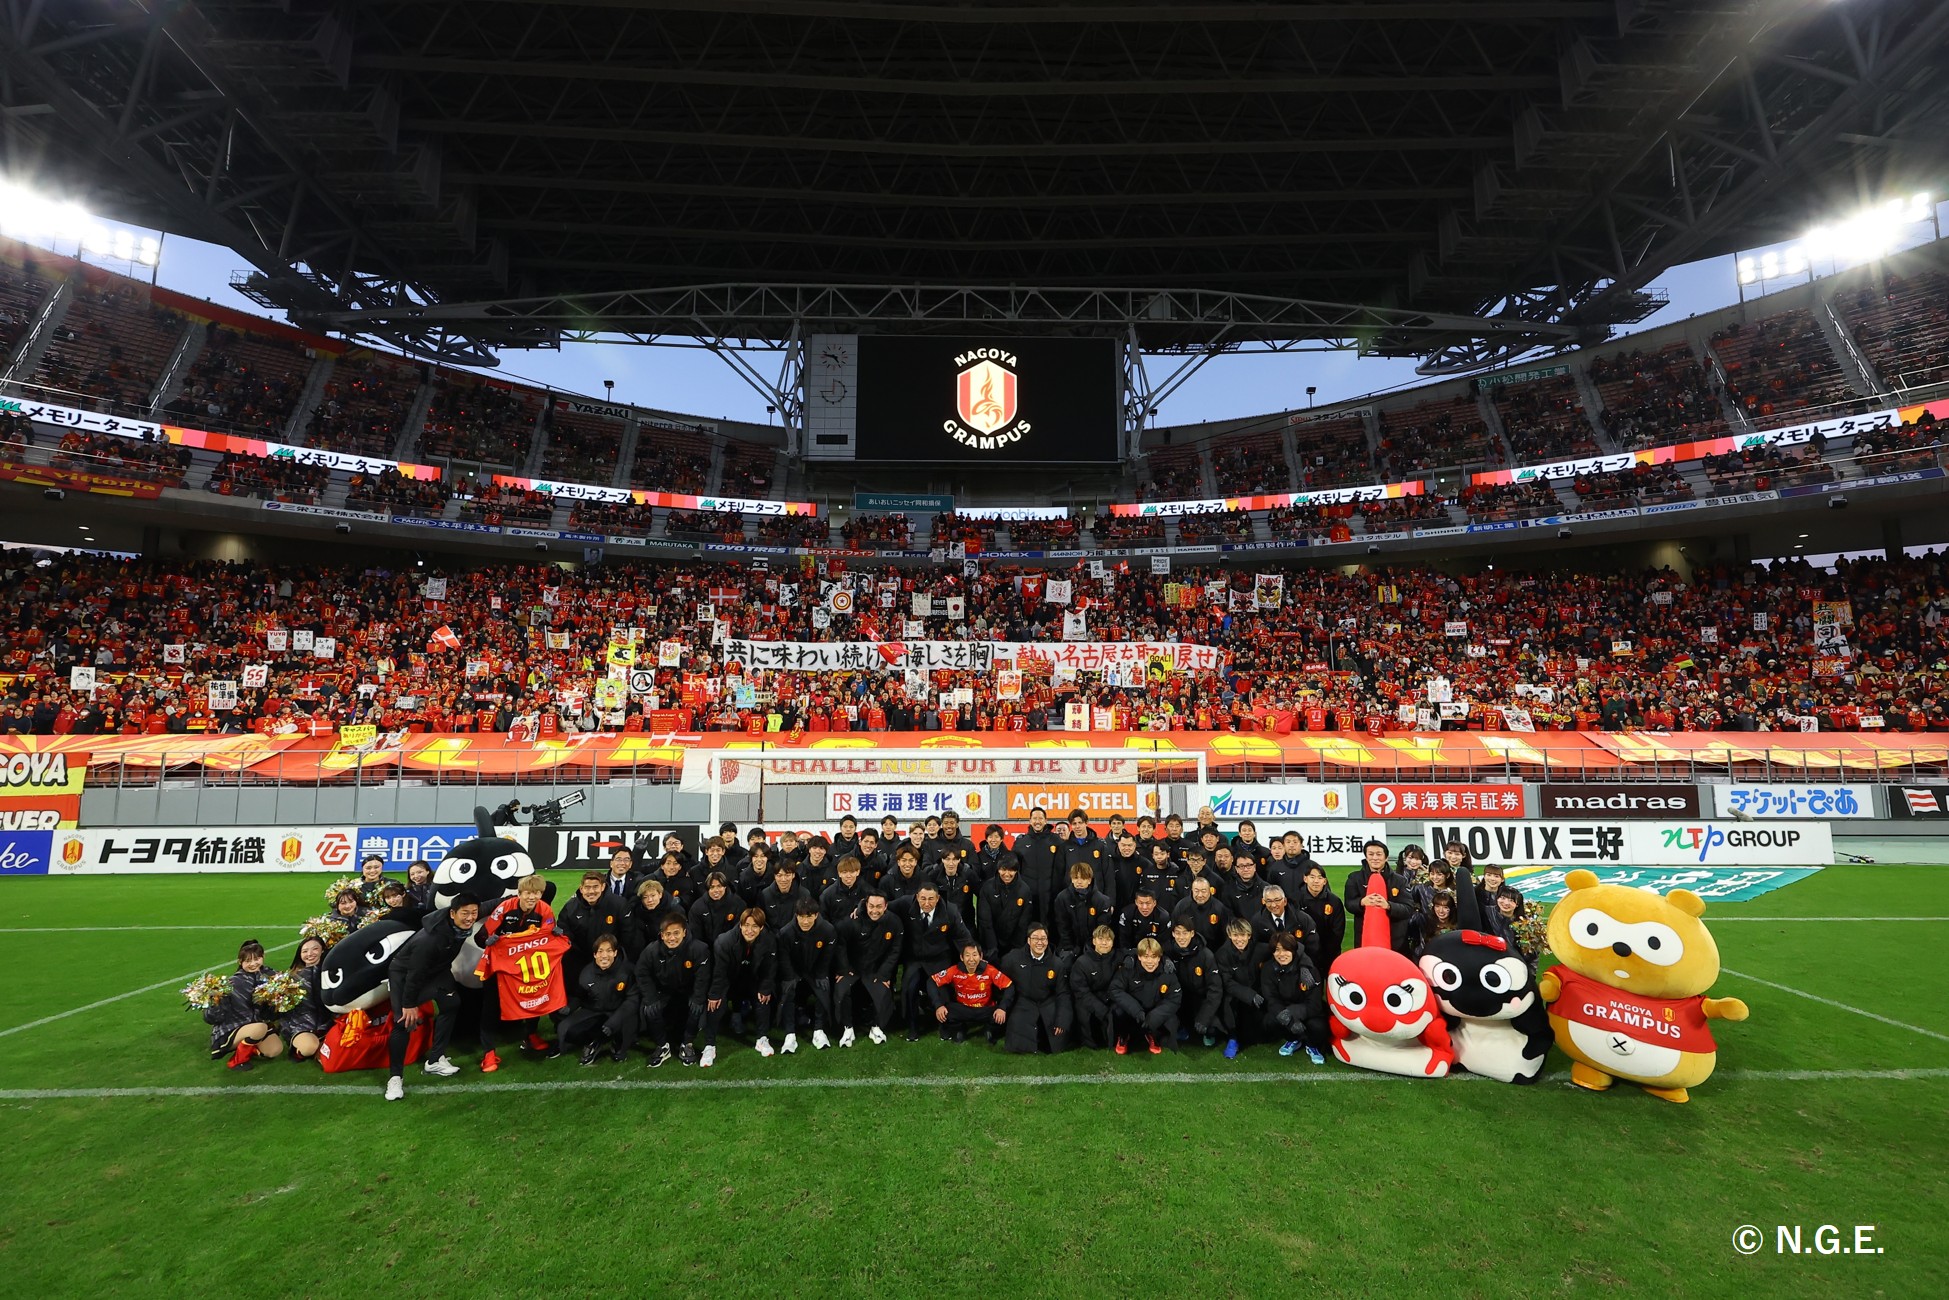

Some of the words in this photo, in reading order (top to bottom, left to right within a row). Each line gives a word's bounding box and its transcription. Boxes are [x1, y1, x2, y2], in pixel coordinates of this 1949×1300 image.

[954, 348, 1018, 367] NAGOYA
[573, 403, 629, 418] YAZAKI
[943, 419, 1032, 449] GRAMPUS
[1540, 456, 1631, 478] メモリーターフ
[554, 485, 629, 502] メモリーターフ
[1312, 488, 1384, 504] メモリーターフ
[718, 500, 783, 514] メモリーターフ
[868, 498, 942, 507] あいおいニッセイ同和損保
[1159, 501, 1223, 514] メモリーターフ
[1646, 502, 1698, 513] TOYODEN
[1351, 532, 1401, 542] ヨタホテル
[650, 540, 694, 549] MARUTAKA
[707, 544, 747, 552] TOYO
[747, 546, 787, 554] TIRES
[808, 549, 875, 557] キョウエイファイン
[726, 641, 1008, 668] 共に味わい続け悔しさを胸に
[1150, 655, 1172, 663] GOAL!
[247, 668, 264, 680] 55
[1164, 670, 1172, 680] 18
[210, 681, 227, 691] 祐也
[1412, 691, 1421, 699] 77
[194, 700, 205, 709] 77
[483, 715, 493, 723] 77
[544, 716, 553, 726] 13
[752, 719, 760, 727] 15
[944, 713, 954, 723] 77
[1014, 720, 1022, 729] 77
[1341, 716, 1351, 725] 77
[1370, 720, 1380, 729] 77
[1487, 716, 1496, 724] 77
[0, 752, 67, 785] OYA
[772, 759, 933, 774] CHALLENGE
[945, 759, 996, 774] FOR
[1013, 759, 1061, 774] THE
[1080, 759, 1127, 774] TOP
[858, 792, 953, 811] 東海理化
[1011, 792, 1070, 810] AICHI
[1078, 792, 1134, 811] STEEL
[1209, 787, 1300, 816] MEITETSU
[1401, 792, 1519, 811] 東海東京証券
[1555, 792, 1687, 810] madras
[1731, 787, 1858, 815] チケットぴあ
[0, 810, 60, 831] VER
[63, 833, 85, 841] NAGOYA
[281, 831, 304, 840] NAGOYA
[1727, 829, 1800, 847] GROUP
[98, 837, 266, 864] トヨタ紡織
[1431, 826, 1560, 862] MOVIX
[1569, 826, 1624, 861] 三好
[57, 859, 87, 871] GRAMPUS
[275, 857, 306, 871] GRAMPUS
[508, 937, 549, 956] DENSO
[515, 951, 551, 984] 10
[1609, 1000, 1653, 1017] NAGOYA
[1582, 1003, 1681, 1039] GRAMPUS
